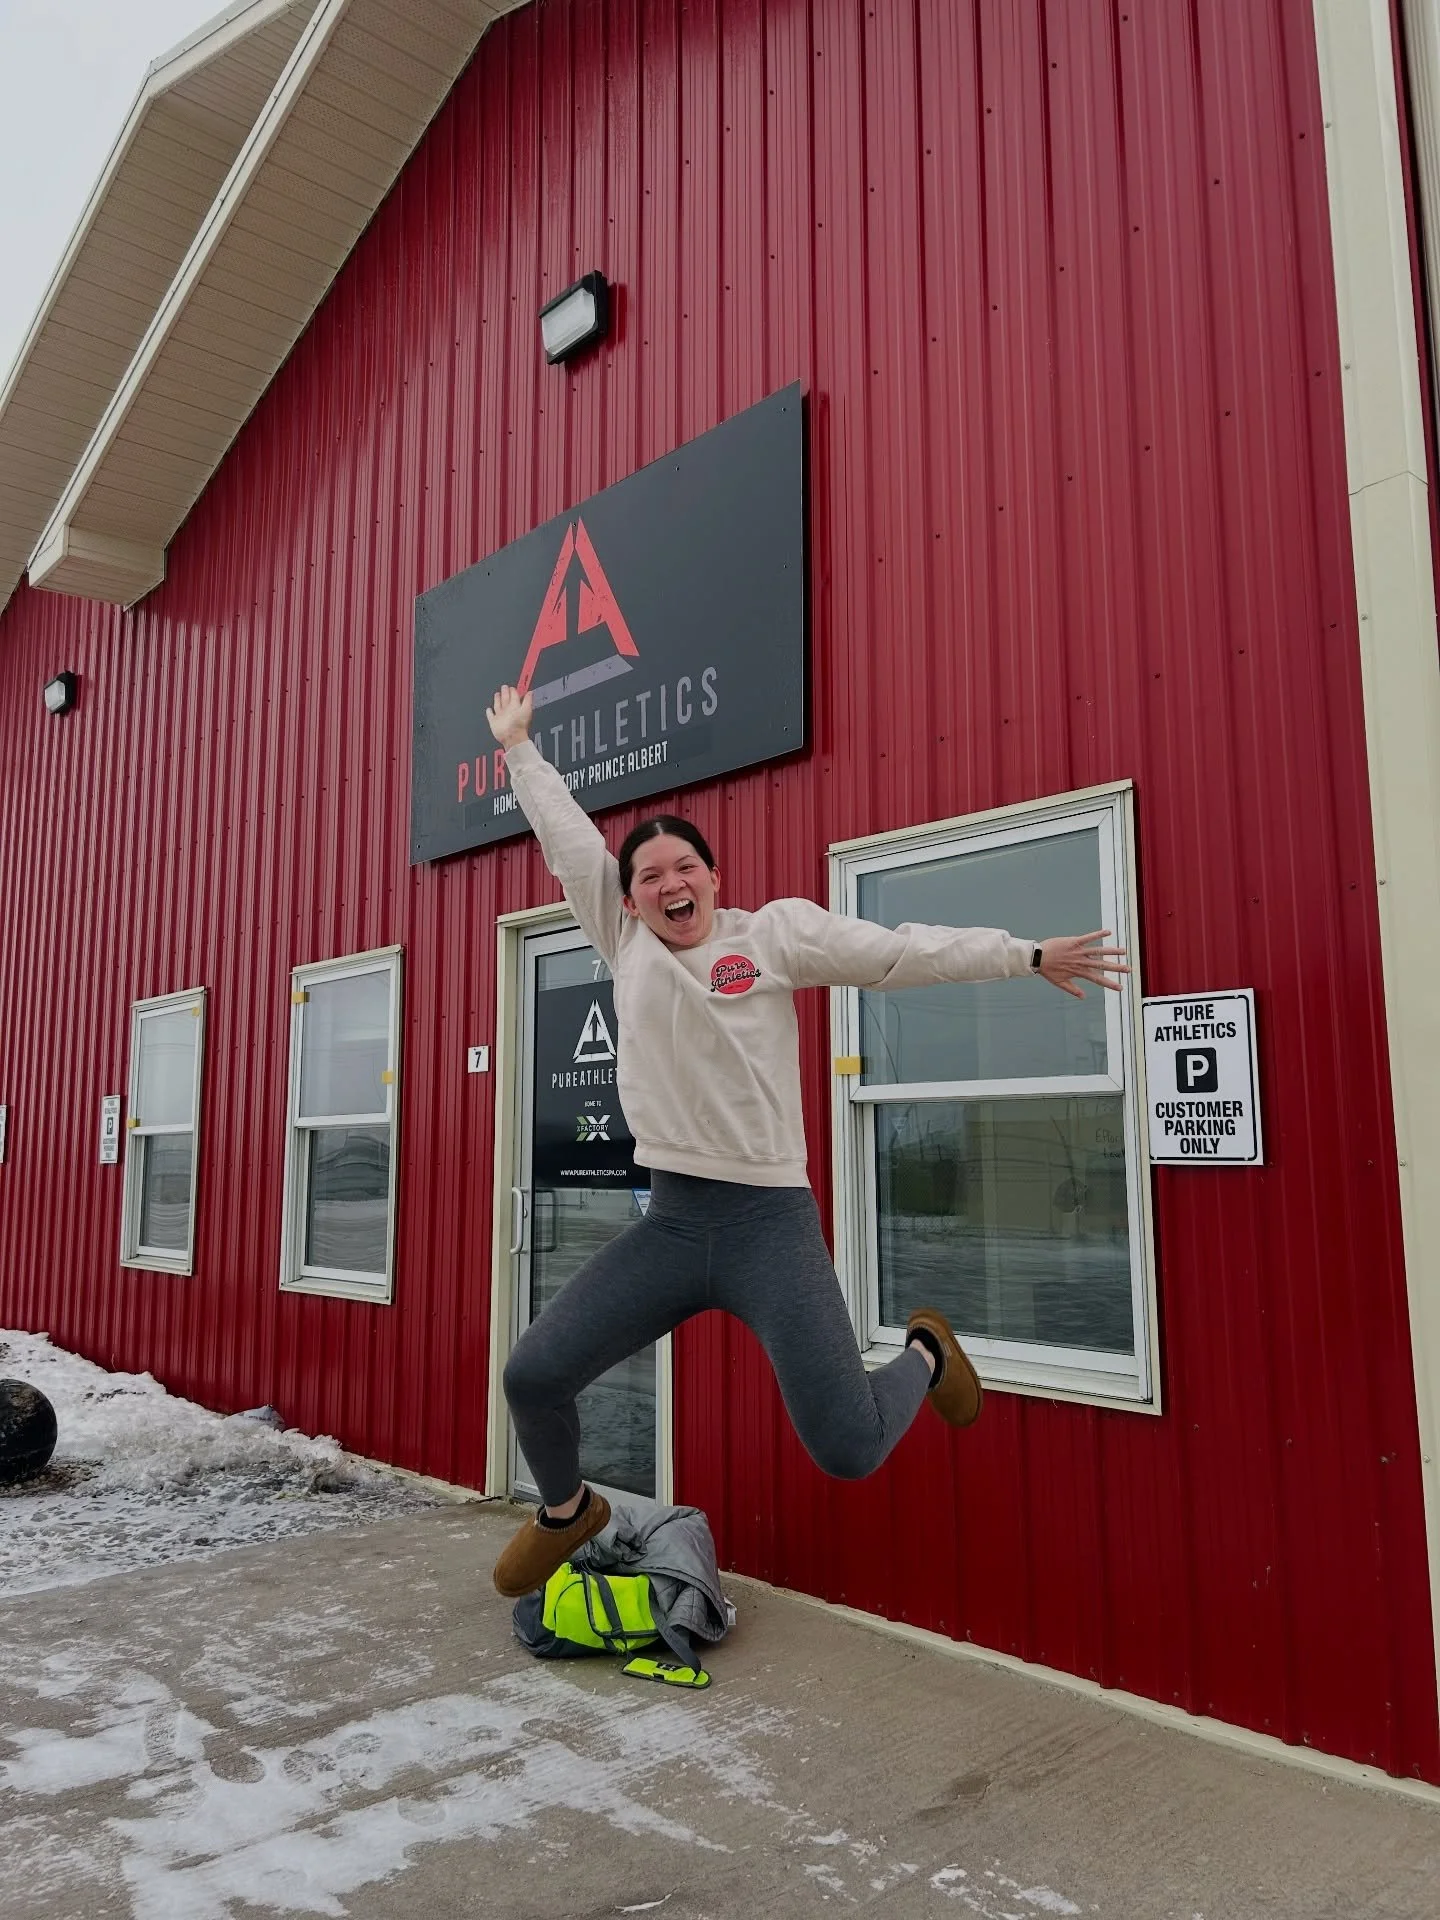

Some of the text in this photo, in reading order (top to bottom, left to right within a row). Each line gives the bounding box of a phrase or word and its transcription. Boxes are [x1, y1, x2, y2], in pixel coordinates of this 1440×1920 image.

[493, 792, 518, 816] HOME
[588, 755, 625, 786] PRINCE
[628, 740, 668, 773] ALBERT
[592, 960, 602, 980] 7
[716, 961, 747, 977] Pure
[711, 969, 761, 992] Athletics
[1173, 1004, 1215, 1022] PURE
[1154, 1022, 1237, 1042] ATHLETICS
[475, 1051, 482, 1068] 7
[552, 1068, 617, 1088] PUREATHLE
[1186, 1054, 1210, 1087] P
[1156, 1100, 1243, 1118] CUSTOMER
[1164, 1119, 1236, 1136] PARKING
[1180, 1138, 1221, 1154] ONLY
